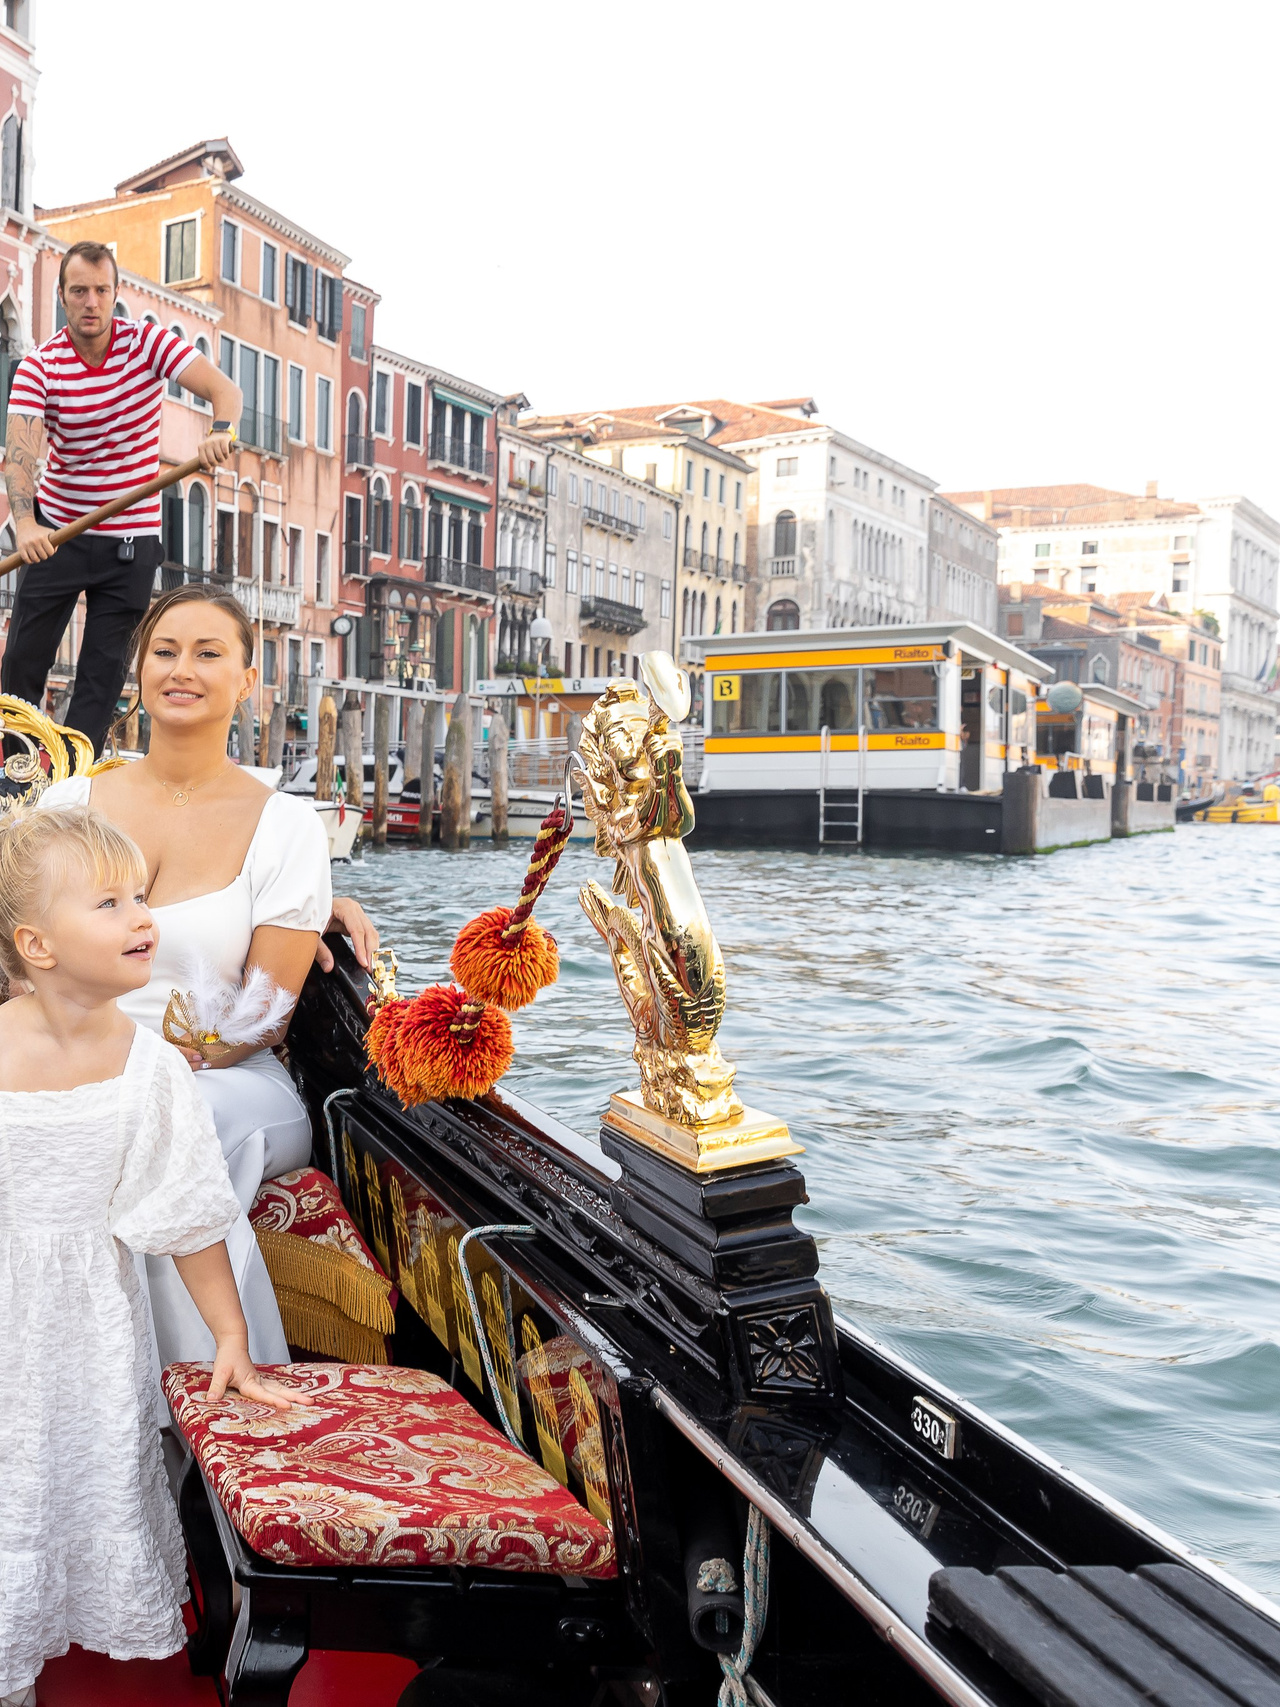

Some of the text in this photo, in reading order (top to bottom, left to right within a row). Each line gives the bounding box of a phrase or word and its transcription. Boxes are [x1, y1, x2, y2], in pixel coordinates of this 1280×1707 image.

[893, 647, 930, 660] Rialto
[506, 680, 517, 693] A
[572, 679, 582, 692] B
[719, 679, 734, 697] B
[894, 735, 931, 747] Rialto
[913, 1406, 940, 1445] 330
